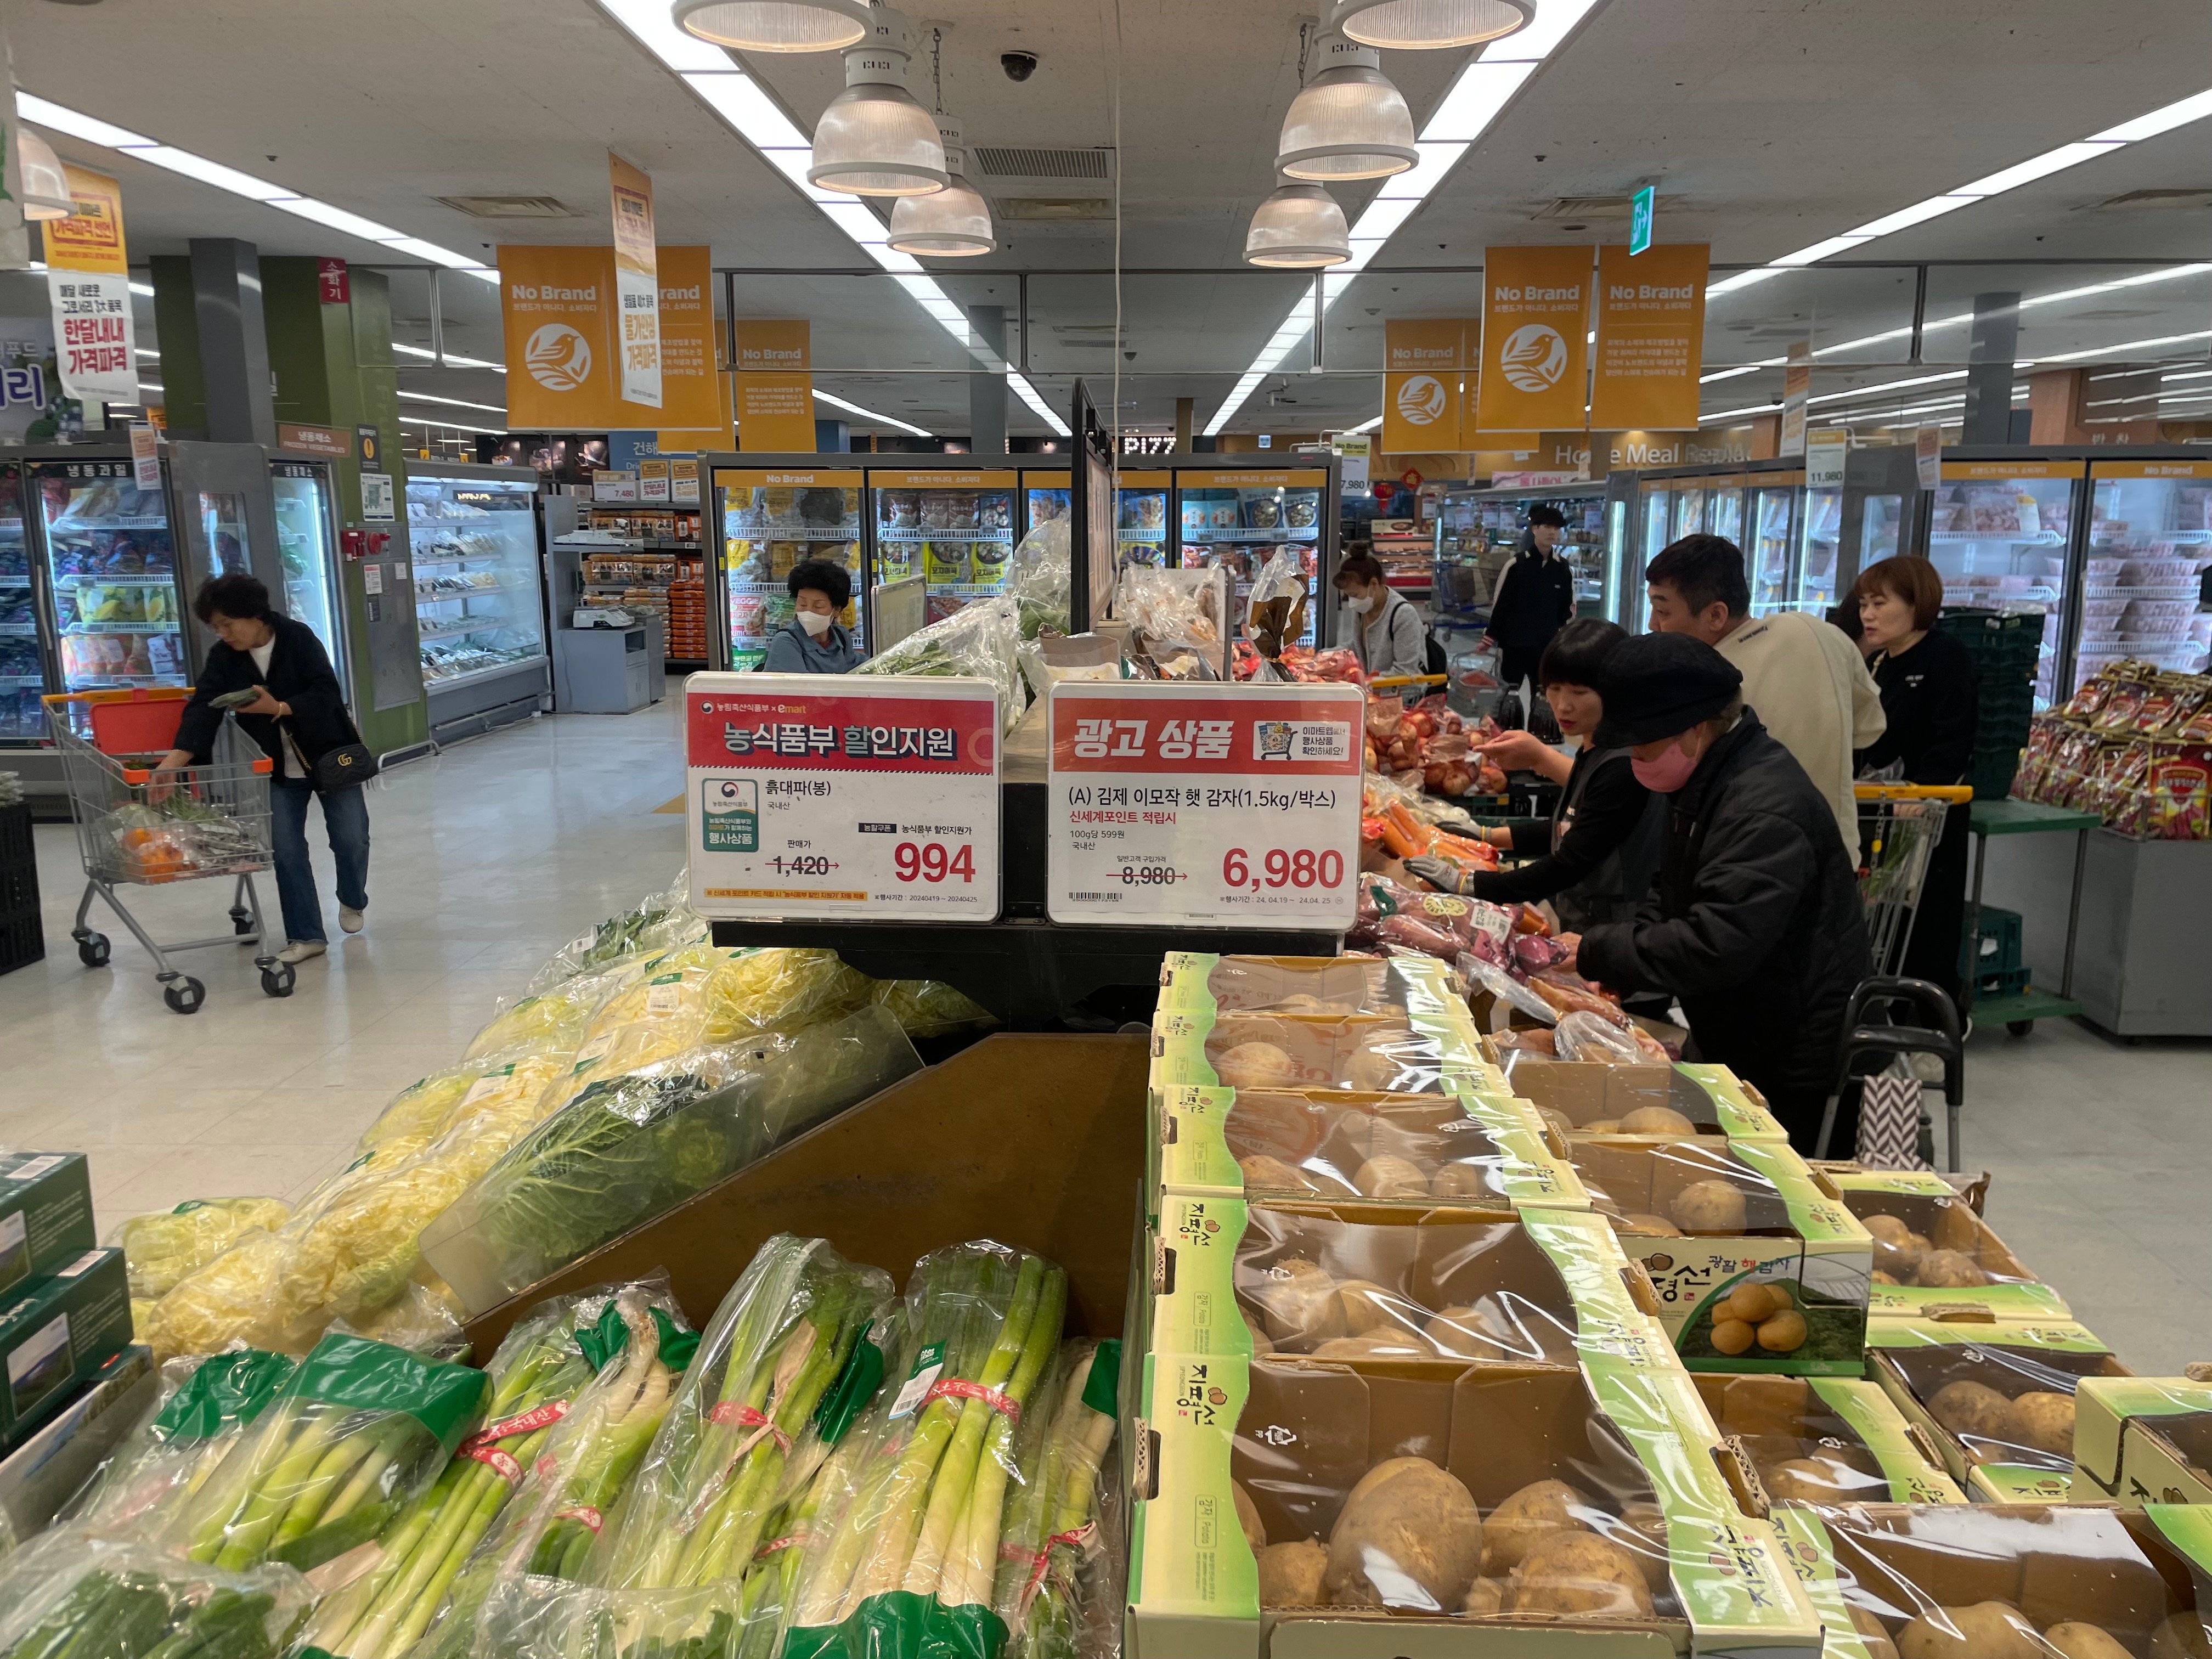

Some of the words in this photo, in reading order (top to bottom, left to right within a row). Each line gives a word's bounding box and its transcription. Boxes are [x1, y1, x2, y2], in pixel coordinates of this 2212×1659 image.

[326, 261, 341, 300] 소화기
[512, 285, 538, 300] No
[541, 285, 596, 301] Brand
[658, 285, 700, 300] rand
[1495, 286, 1521, 301] No
[1525, 285, 1580, 301] Brand
[1610, 285, 1635, 300] No
[1638, 283, 1694, 300] Brand
[513, 303, 541, 312] 브랜드가
[63, 318, 125, 345] 한달내내
[625, 314, 655, 341] 물가안정
[627, 343, 658, 371] 가격파격
[742, 349, 761, 359] No
[763, 348, 802, 359] Brand
[1392, 348, 1411, 359] No
[1413, 346, 1454, 358] Brand
[67, 346, 127, 375] 가격파격
[298, 431, 331, 443] 냉동채소
[308, 443, 346, 454] VEGETABLES
[1626, 443, 1679, 464] Meal
[67, 465, 126, 477] 냉동과일
[2161, 465, 2194, 475] Brand
[766, 475, 781, 483] No
[782, 474, 814, 483] Brand
[716, 703, 769, 713] 농림축산식품부
[777, 704, 806, 714] emart
[1302, 726, 1346, 736] 이마트앱에서
[723, 721, 836, 757] 농식품부
[843, 725, 955, 759] 할인지원
[1074, 719, 1149, 759] 광고
[1157, 720, 1235, 760] 상품
[1302, 736, 1333, 746] 행사상품
[1302, 747, 1344, 755] 확인하세요!
[765, 780, 831, 798] 흙대파(봉)
[768, 802, 790, 810] 국내산
[1068, 787, 1091, 806] (A)
[1097, 787, 1127, 807] 김제
[1133, 787, 1181, 808] 이모작
[1186, 788, 1201, 808] 햇
[1206, 789, 1336, 810] 감자(1.5kg/박스)
[1069, 810, 1138, 824] 신세계포인트
[1142, 811, 1176, 825] 적립시
[901, 825, 932, 834] 농식품부
[934, 825, 973, 836] 할인지원가
[1069, 830, 1098, 839] 100g당
[1101, 830, 1125, 839] 599원
[709, 832, 753, 845] 행사상품
[787, 839, 811, 850] 판매가
[1071, 842, 1096, 850] 국내산
[772, 856, 830, 878] 1,420
[894, 842, 977, 883] 994
[1122, 866, 1176, 887] 8,980
[1223, 848, 1344, 893] 6,980
[910, 895, 940, 903] 20240419
[947, 895, 978, 904] 20240425
[1179, 1087, 1205, 1114] 지평선
[1179, 1203, 1211, 1246] 지평선
[1176, 1364, 1216, 1426] 지평선
[1198, 1498, 1214, 1518] 감자
